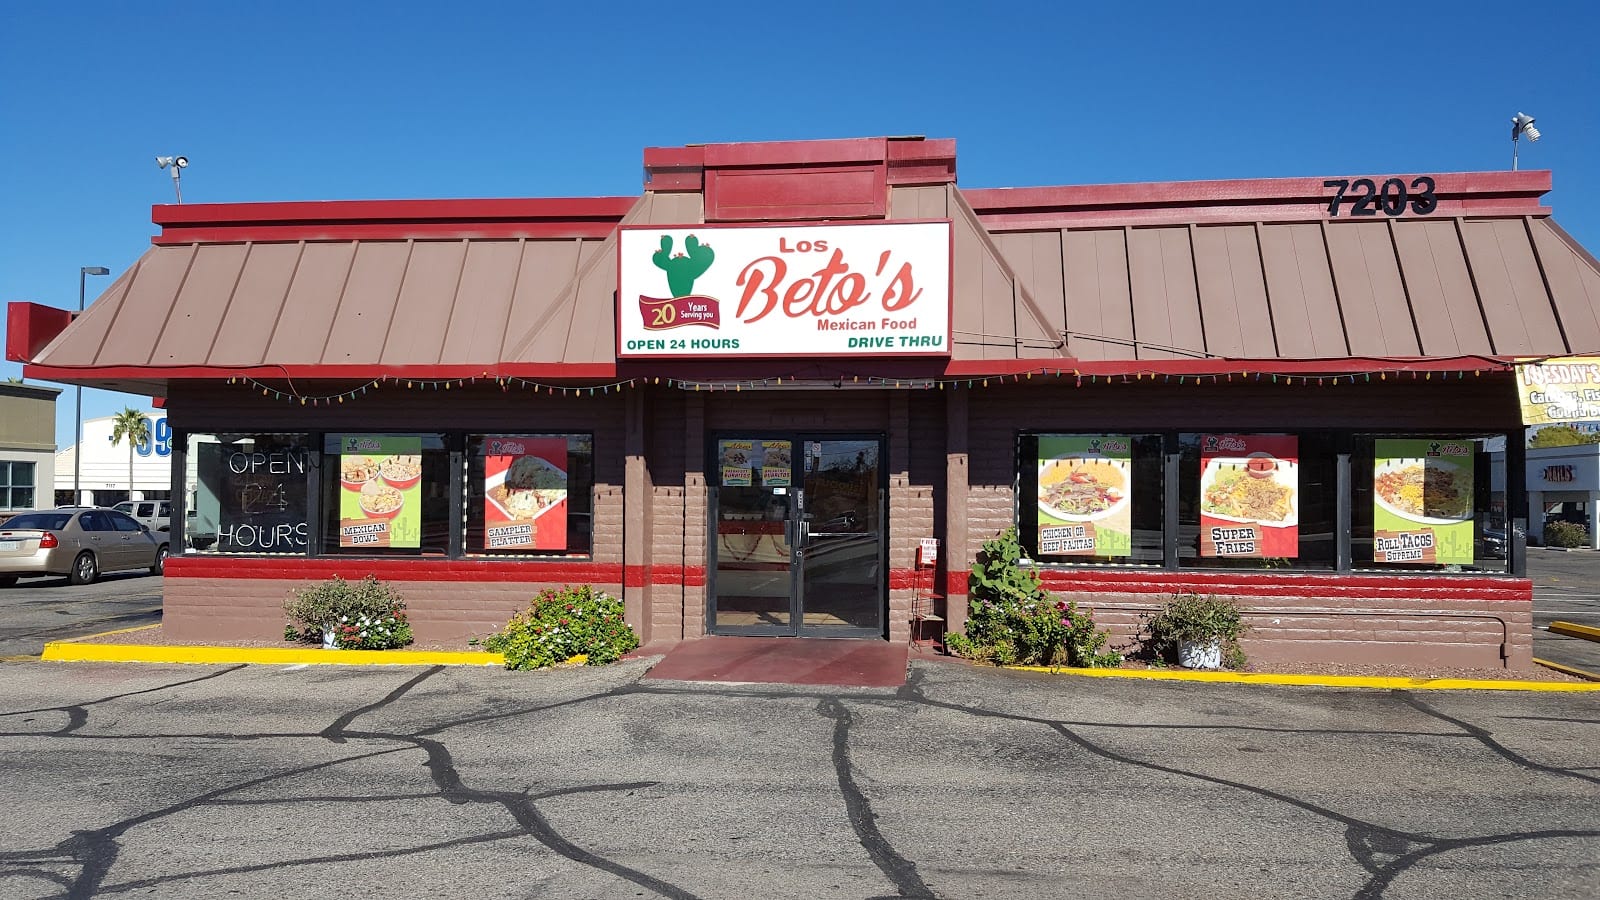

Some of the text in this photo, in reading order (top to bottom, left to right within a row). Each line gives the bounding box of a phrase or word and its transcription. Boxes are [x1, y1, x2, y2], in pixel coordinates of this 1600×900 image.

[1322, 176, 1438, 216] 7203
[779, 237, 828, 253] Los
[735, 248, 923, 324] Beto's
[688, 302, 707, 312] Years
[651, 304, 676, 326] 20
[680, 310, 714, 320] Serving you
[817, 317, 917, 331] Mexican Food
[627, 339, 740, 350] OPEN 24 HOURS
[848, 335, 942, 348] DRIVE THRU
[229, 452, 304, 474] OPEN
[217, 523, 308, 548] HOURS
[344, 523, 386, 535] MEXICAN
[488, 525, 531, 537] SAMPLER
[1042, 526, 1084, 539] CHICKEN OR
[1212, 528, 1255, 541] SUPER
[353, 534, 378, 543] BOWL
[491, 536, 531, 546] PLATTER
[1043, 538, 1093, 552] BEEF FAJITAS
[1377, 534, 1432, 550] ROLL TACOS
[1215, 541, 1254, 554] FRIES
[1386, 550, 1422, 561] SUPREME
